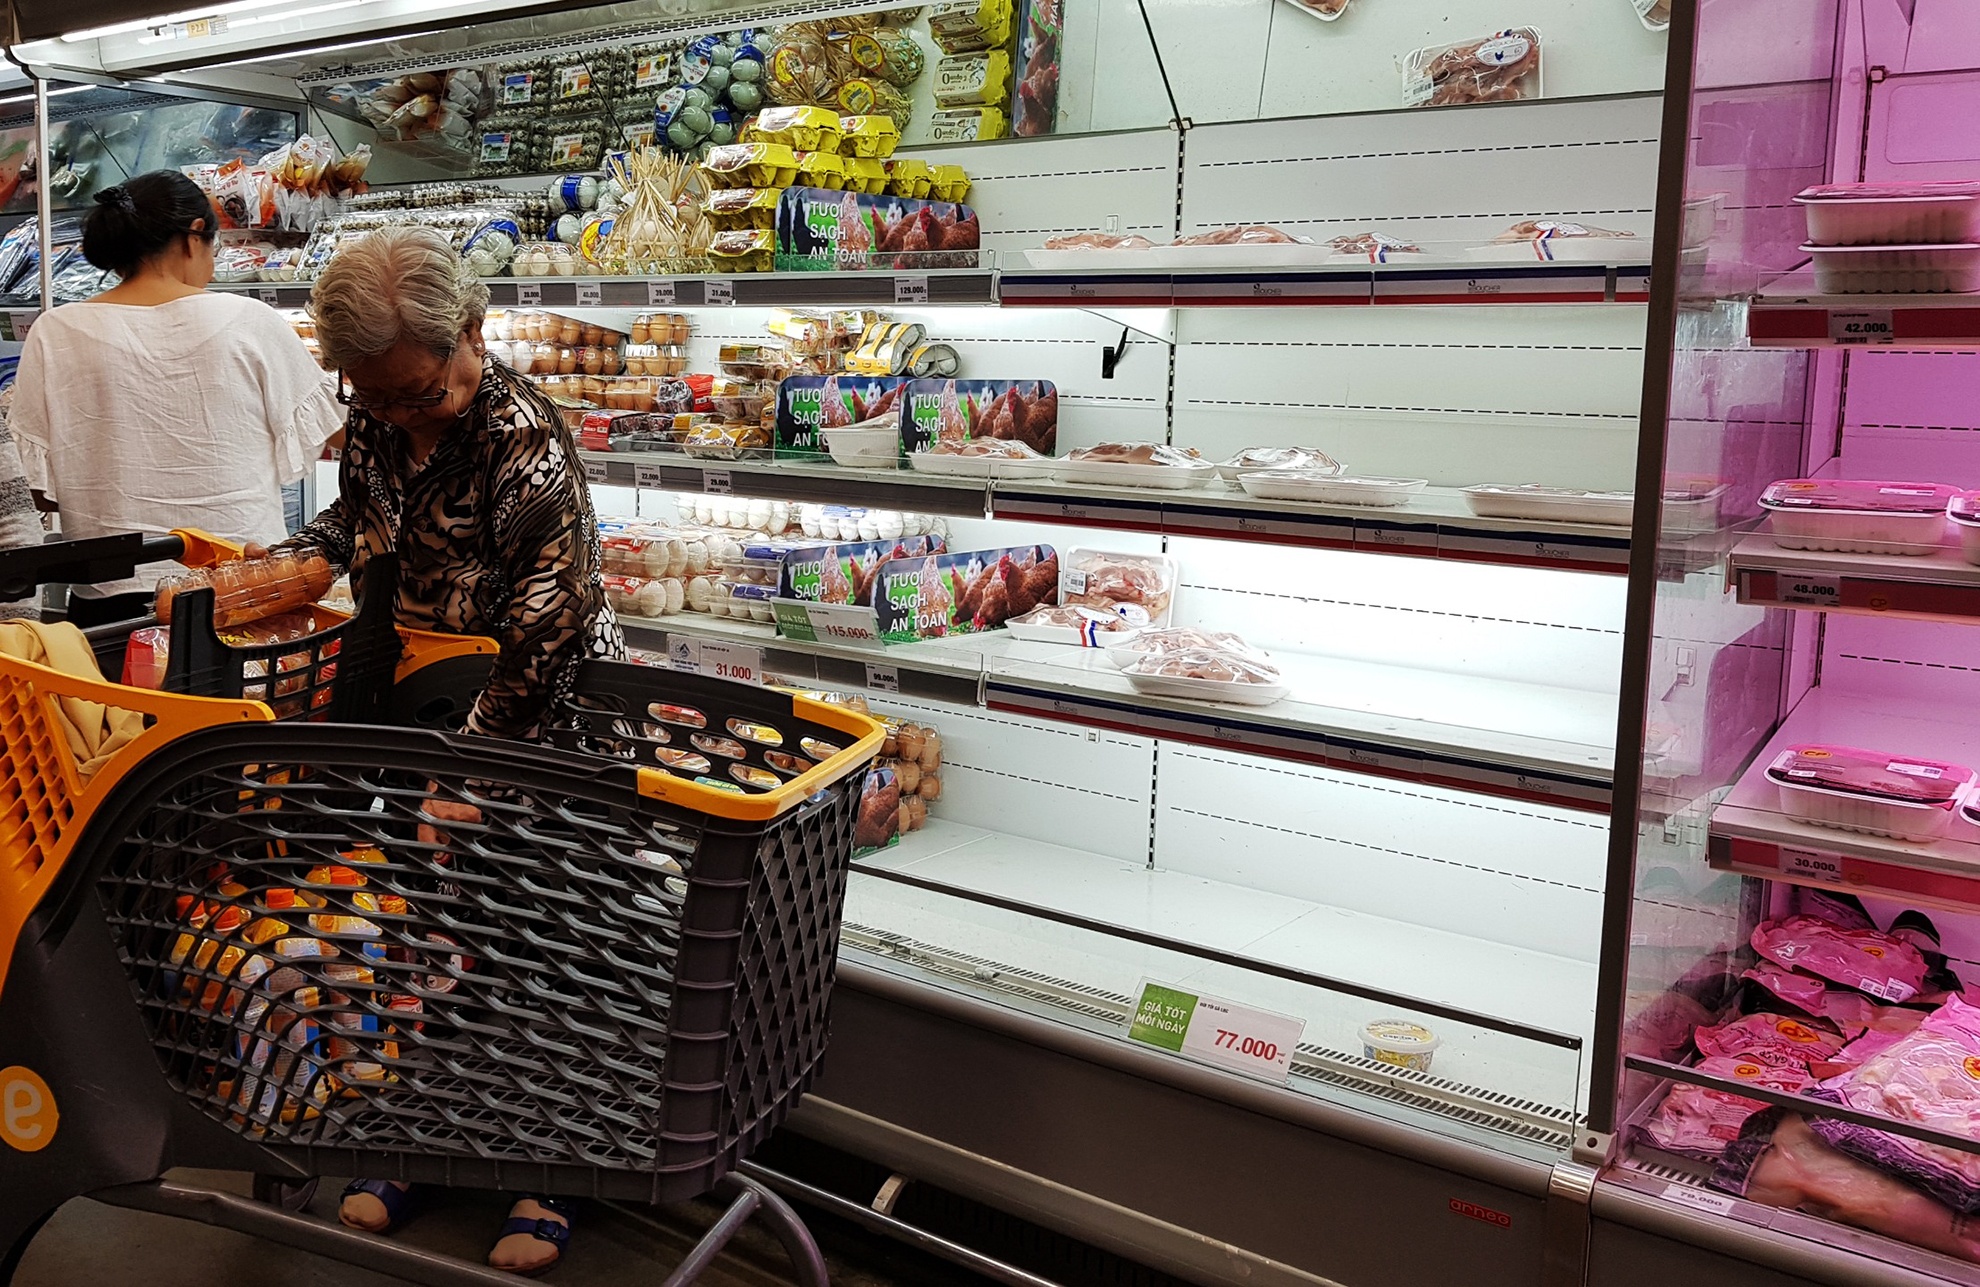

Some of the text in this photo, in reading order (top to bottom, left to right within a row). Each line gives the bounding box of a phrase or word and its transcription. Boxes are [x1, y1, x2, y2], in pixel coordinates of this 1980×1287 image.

[809, 224, 847, 243] SẠCH
[808, 246, 827, 261] AN
[1845, 323, 1887, 333] 42.000
[794, 411, 829, 430] SẠCH
[915, 417, 947, 437] SẠCH
[793, 433, 811, 447] AN
[1793, 583, 1835, 596] 48.000
[890, 593, 926, 613] SẠCH
[890, 617, 908, 633] AN
[716, 662, 751, 680] 31.000
[1795, 857, 1836, 872] 30.000
[1143, 999, 1187, 1020] GIÁ TỐT
[1215, 1029, 1277, 1061] 77.000
[1680, 1192, 1722, 1206] 79.000
